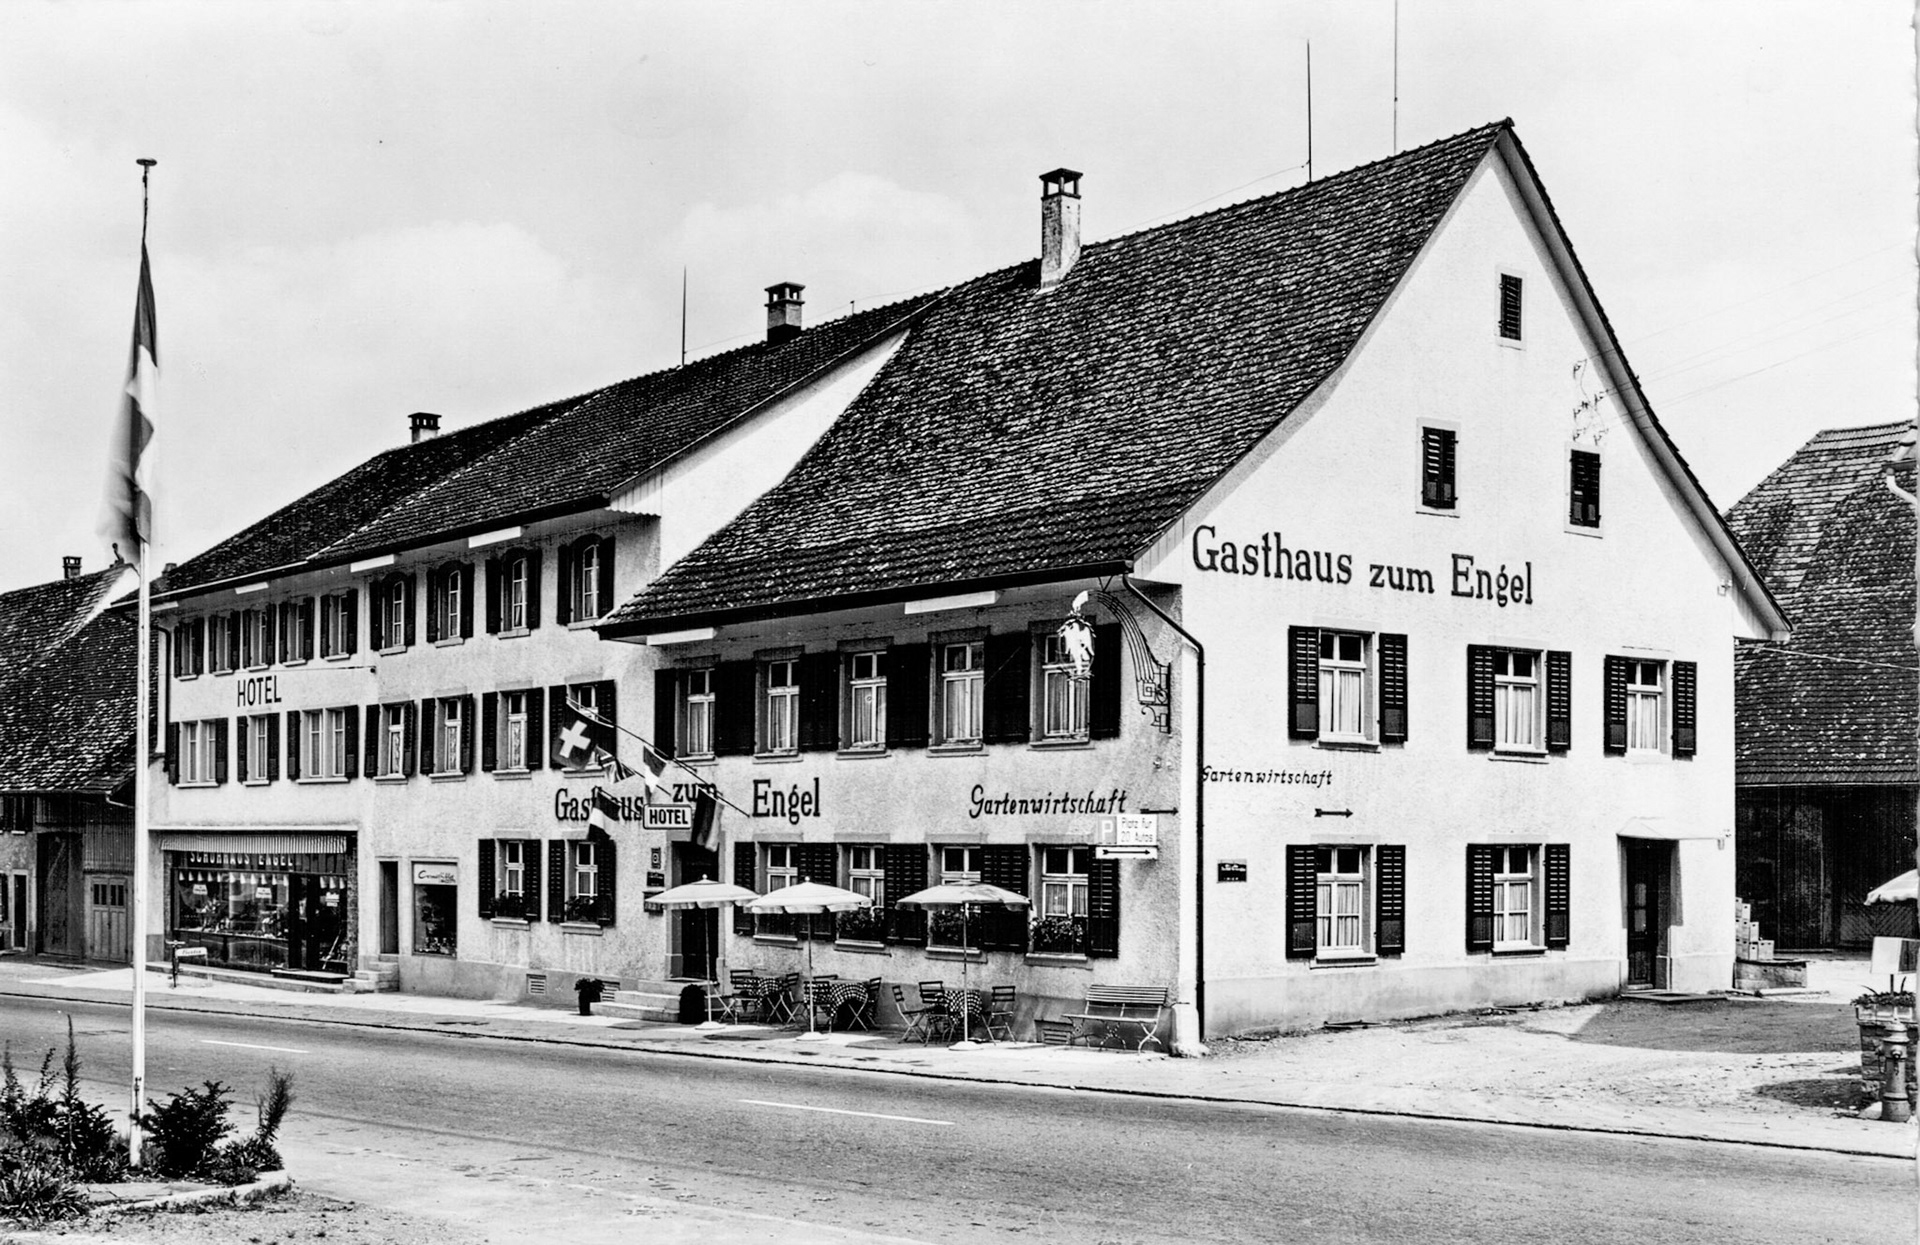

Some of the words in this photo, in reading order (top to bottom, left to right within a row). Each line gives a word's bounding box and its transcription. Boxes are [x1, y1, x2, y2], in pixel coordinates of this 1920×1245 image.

[1192, 524, 1353, 585] Gasthaus
[1369, 562, 1435, 594] zum
[1450, 553, 1533, 607] Engel
[237, 675, 282, 707] HOTEL
[1201, 765, 1332, 788] Gartenwirtschaft
[650, 809, 688, 825] HOTEL
[752, 777, 820, 825] Engel
[969, 784, 1127, 819] Gartenwirtschaft
[1101, 819, 1114, 841] P
